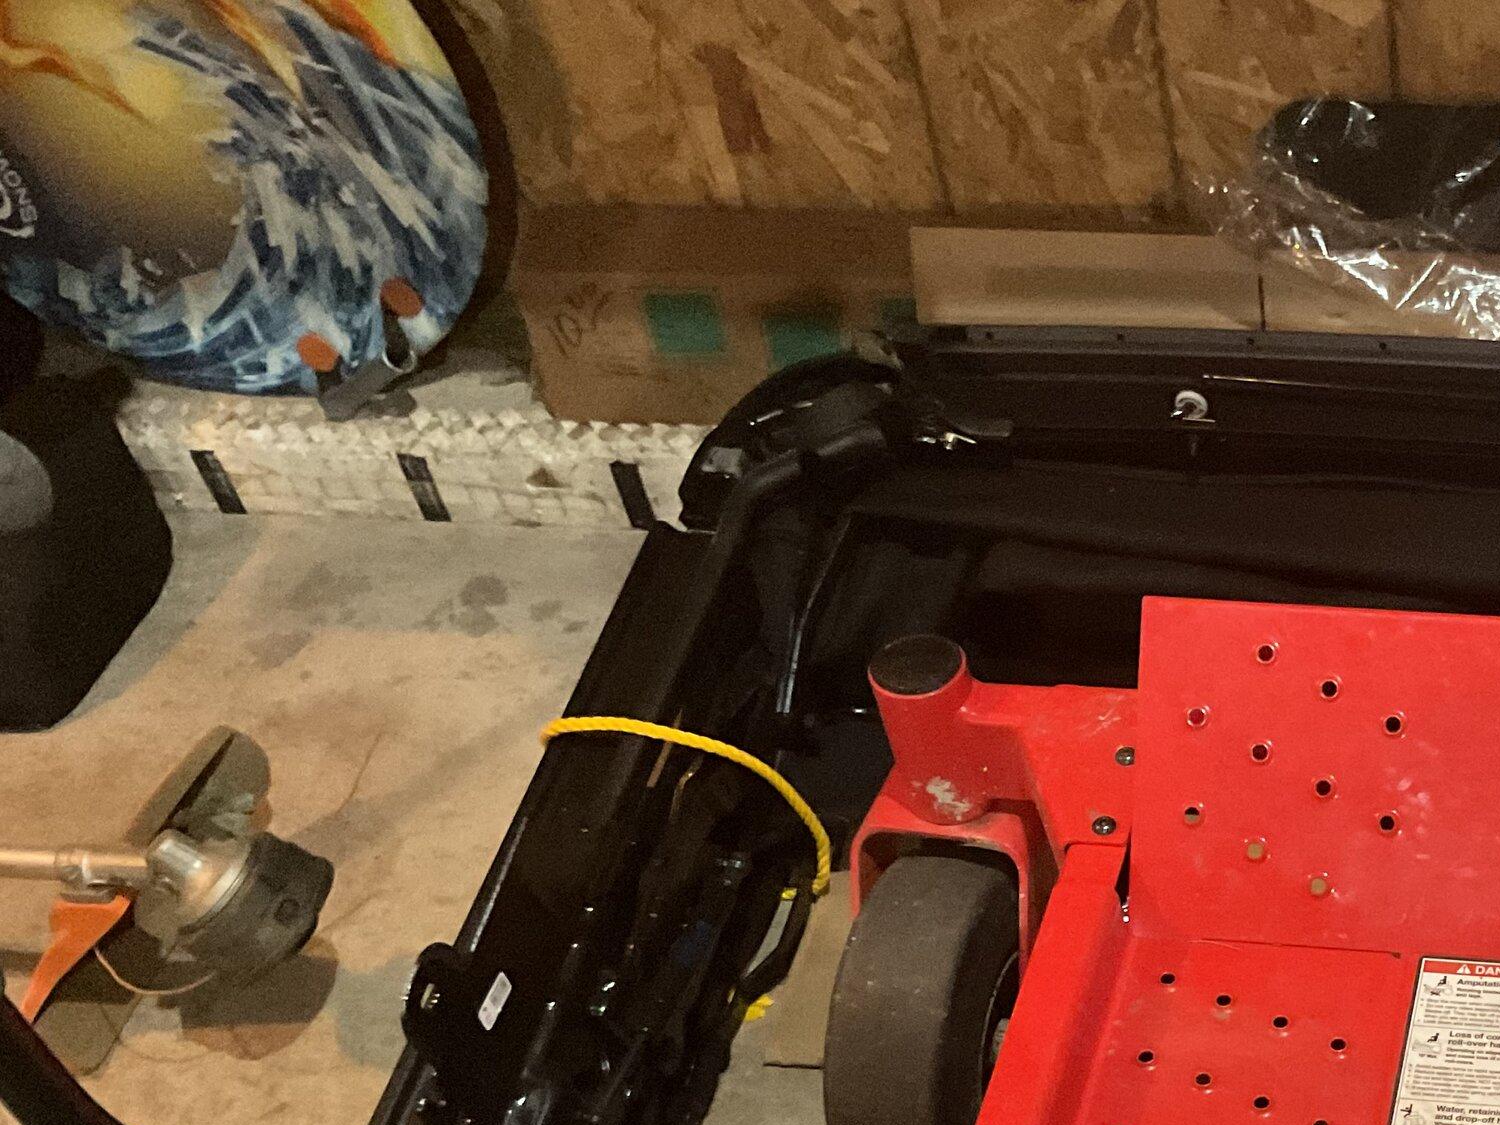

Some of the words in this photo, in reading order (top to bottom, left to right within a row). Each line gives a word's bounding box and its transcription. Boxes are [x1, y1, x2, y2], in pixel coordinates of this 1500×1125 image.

[1449, 1031, 1471, 1039] Loss
[1447, 1039, 1487, 1047] roll-over
[1436, 1105, 1466, 1115] Water,
[1455, 1116, 1494, 1124] drop-off
